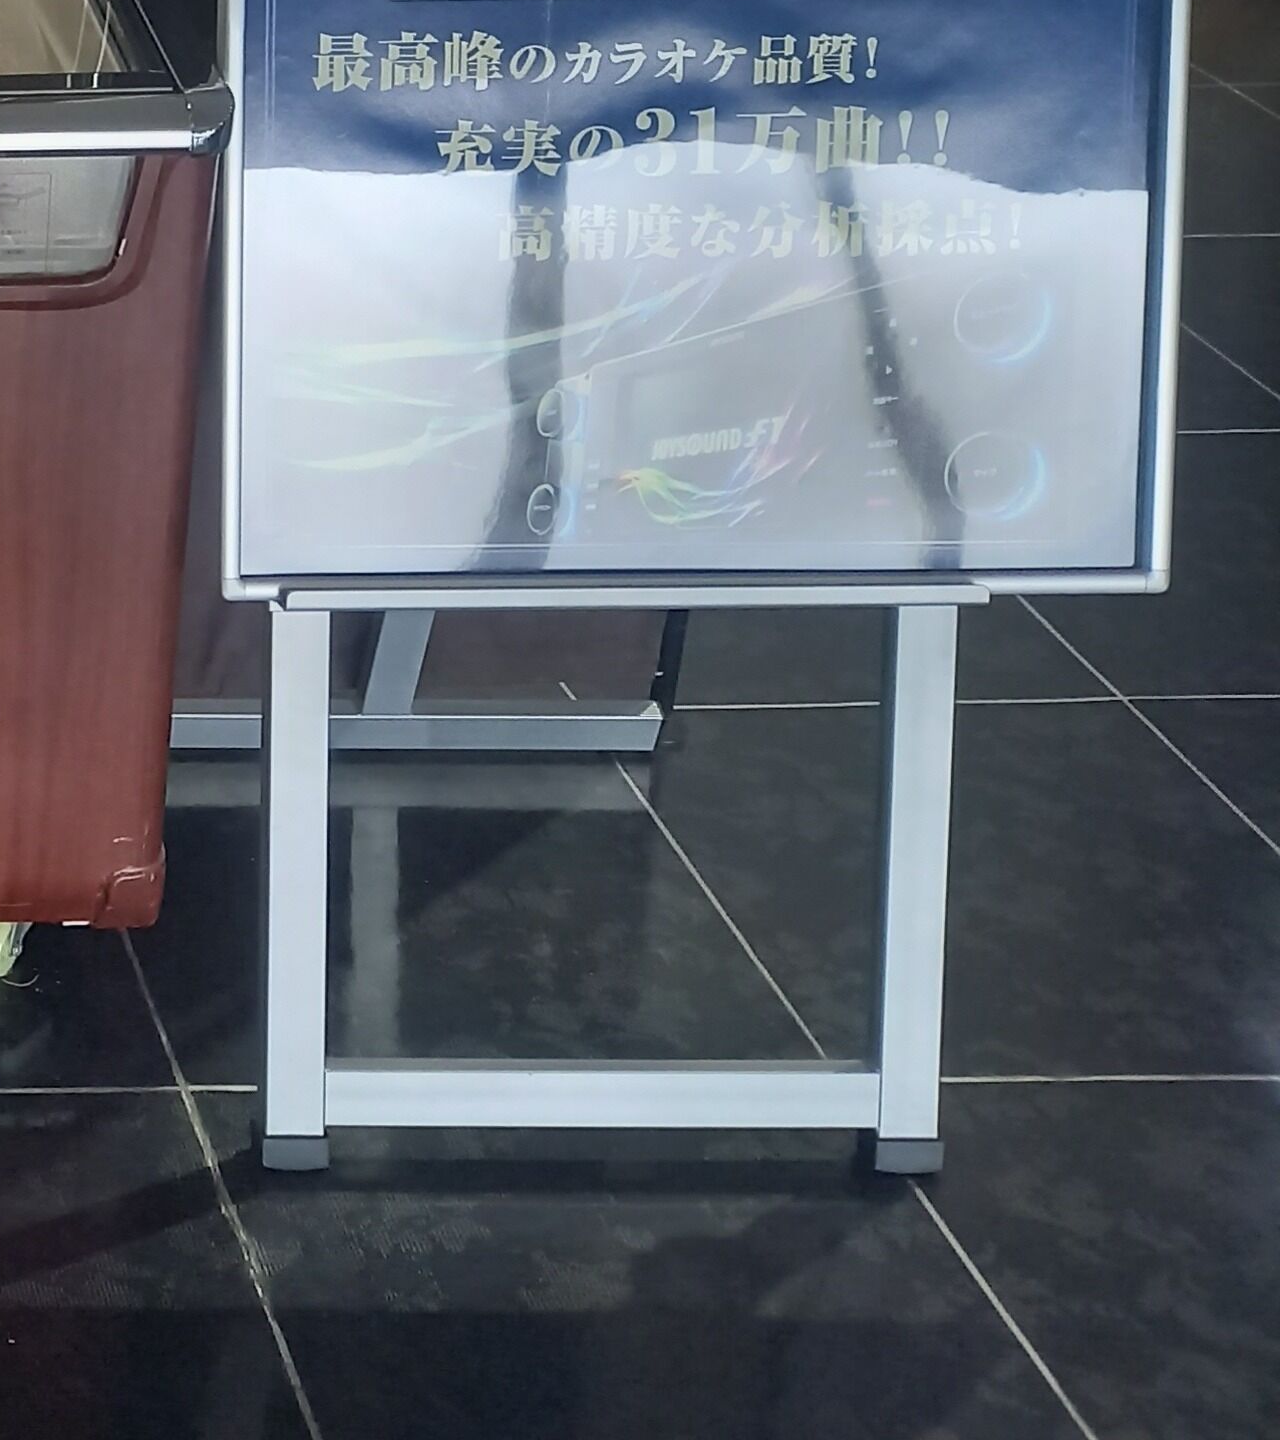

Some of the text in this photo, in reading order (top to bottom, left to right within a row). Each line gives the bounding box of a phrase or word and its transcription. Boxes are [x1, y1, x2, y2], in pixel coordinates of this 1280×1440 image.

[312, 32, 879, 94] 最高峰のカラオケ品質!
[434, 106, 951, 178] 充実の31万曲!!
